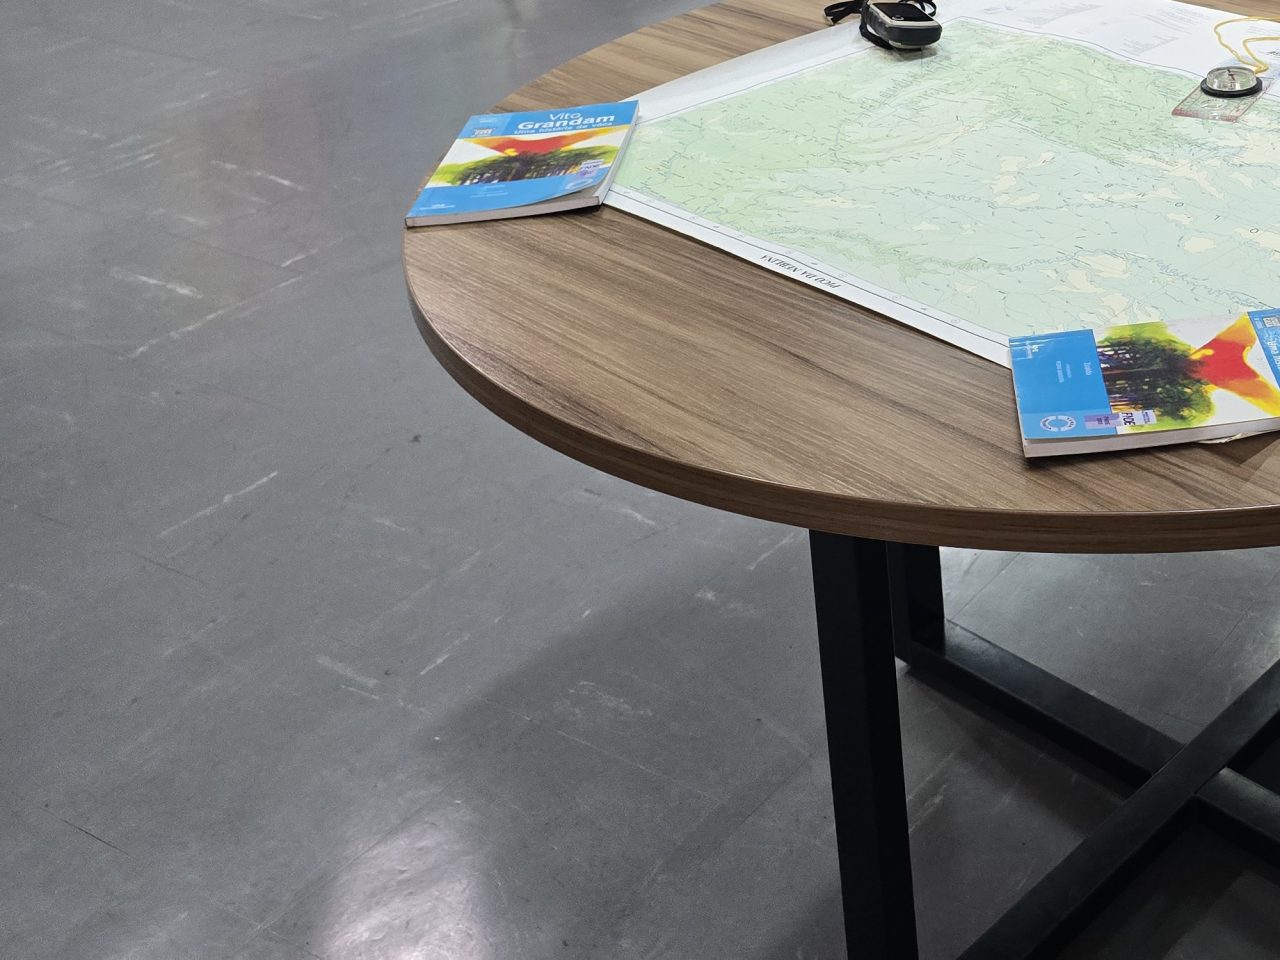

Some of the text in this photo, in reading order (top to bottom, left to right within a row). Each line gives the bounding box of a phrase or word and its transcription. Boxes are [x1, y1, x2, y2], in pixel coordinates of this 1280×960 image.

[517, 115, 615, 130] Grandam
[549, 112, 581, 121] Vito
[760, 255, 842, 289] PICO DA NEBLINA
